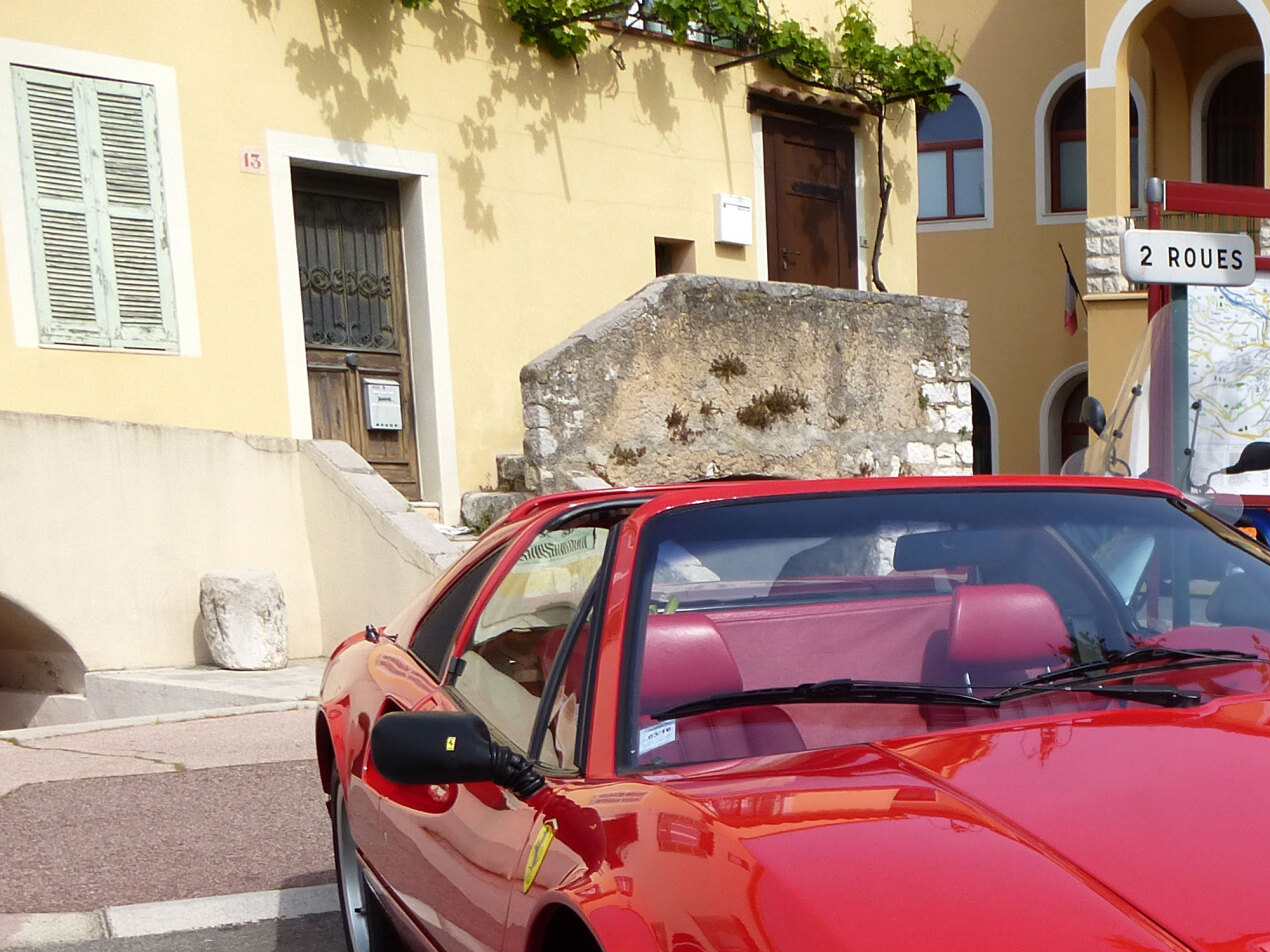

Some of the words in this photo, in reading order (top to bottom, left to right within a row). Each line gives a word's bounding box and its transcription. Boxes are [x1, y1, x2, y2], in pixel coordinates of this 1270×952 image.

[243, 151, 261, 169] 13
[1140, 245, 1153, 267] 2
[1168, 246, 1243, 271] ROUES
